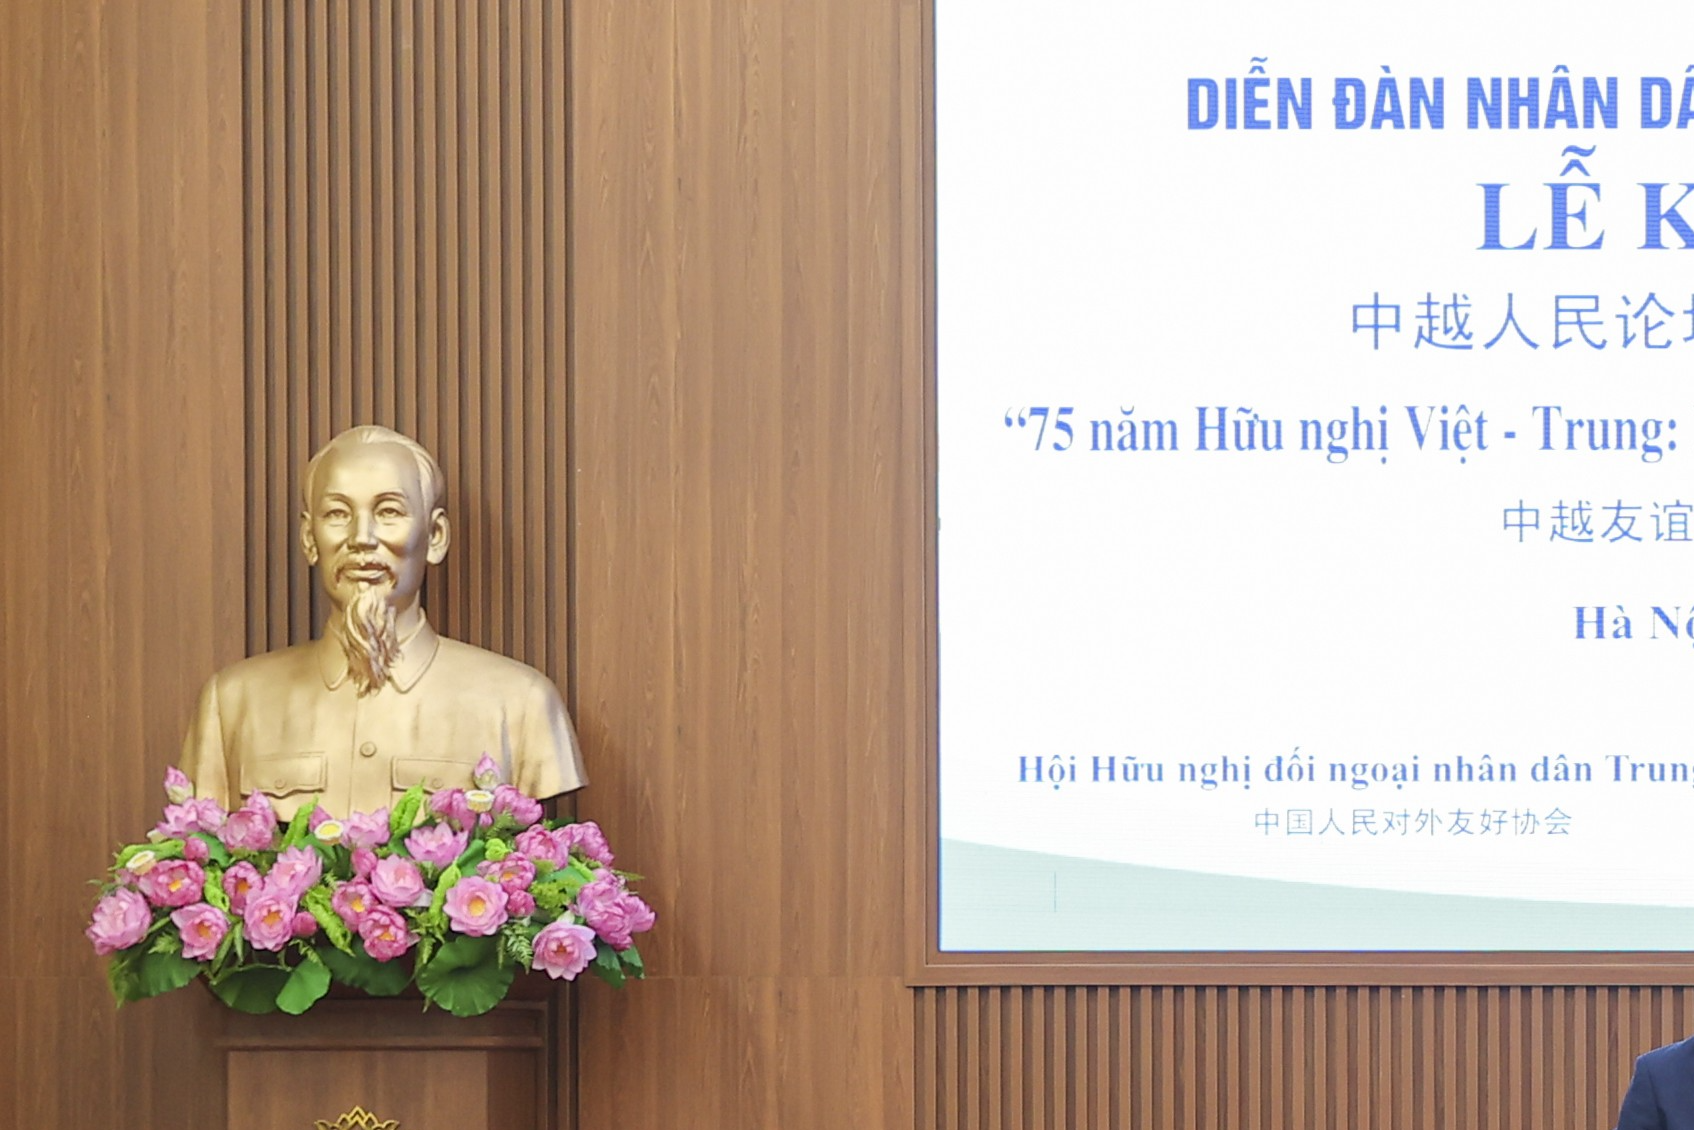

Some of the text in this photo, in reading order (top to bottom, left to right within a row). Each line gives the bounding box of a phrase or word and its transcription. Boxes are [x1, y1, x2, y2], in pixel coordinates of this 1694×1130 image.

[1188, 57, 1312, 130] DIỄN
[1333, 65, 1444, 130] ĐÀN
[1467, 64, 1618, 129] NHÂN
[1476, 145, 1605, 250] LỄ
[1004, 406, 1074, 452] “75
[1091, 405, 1179, 452] năm
[1195, 405, 1284, 452] Hữu
[1300, 405, 1389, 464] nghị
[1406, 404, 1489, 464] Việt
[1533, 405, 1678, 463] Trung:
[1575, 604, 1633, 640] Hà
[1018, 753, 1077, 792] Hội
[1092, 754, 1164, 784] Hữu
[1179, 754, 1251, 791] nghị
[1264, 746, 1315, 783] đối
[1329, 754, 1420, 791] ngoại
[1433, 753, 1517, 783] nhân
[1530, 753, 1593, 783] dân
[1254, 805, 1572, 837] 中国人民对外友好协会
